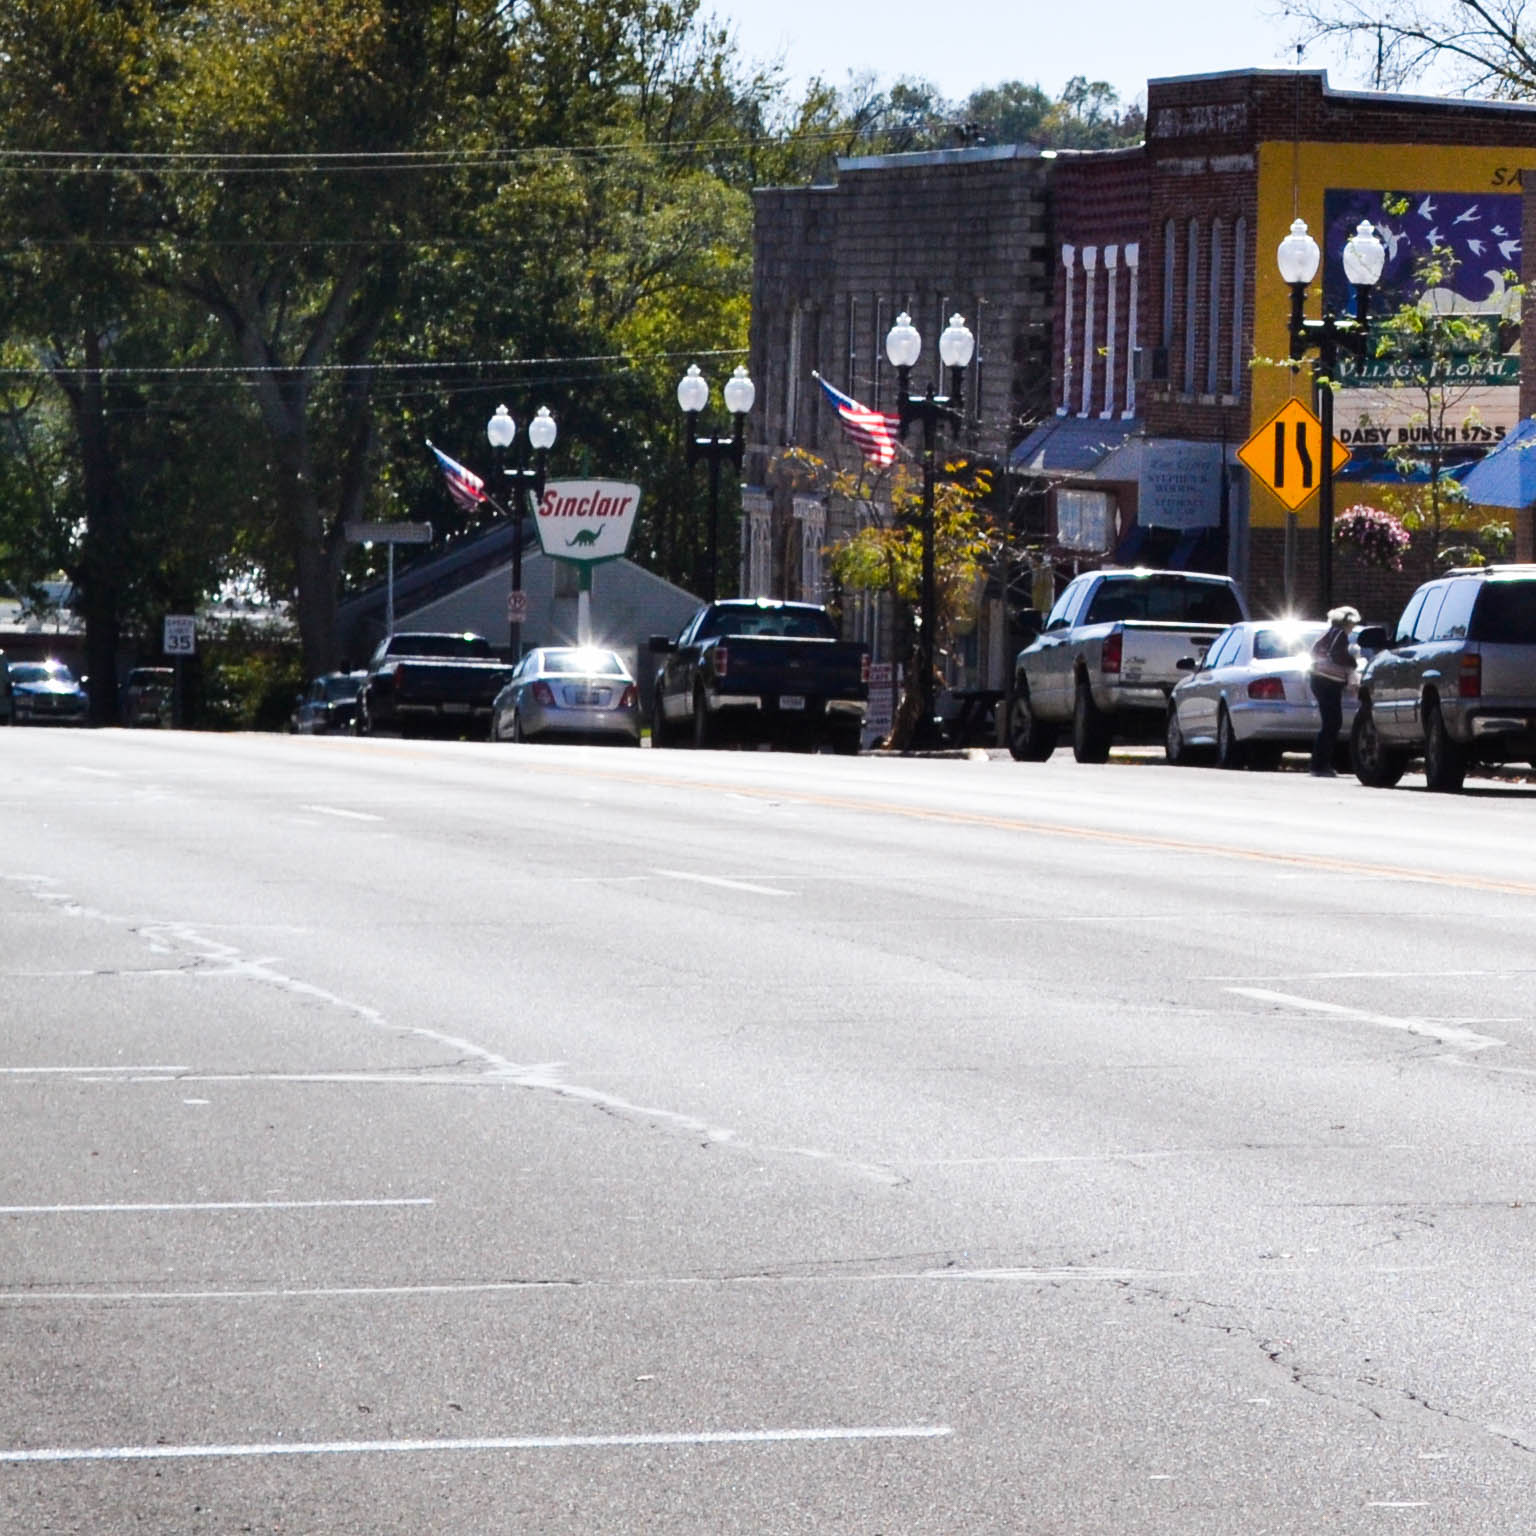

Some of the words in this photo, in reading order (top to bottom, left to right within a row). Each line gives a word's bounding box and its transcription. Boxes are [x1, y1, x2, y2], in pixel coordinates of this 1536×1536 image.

[1340, 428, 1391, 443] DAISY
[1398, 427, 1457, 443] BUNCH
[539, 489, 632, 517] Sinclair
[168, 635, 191, 650] 35
